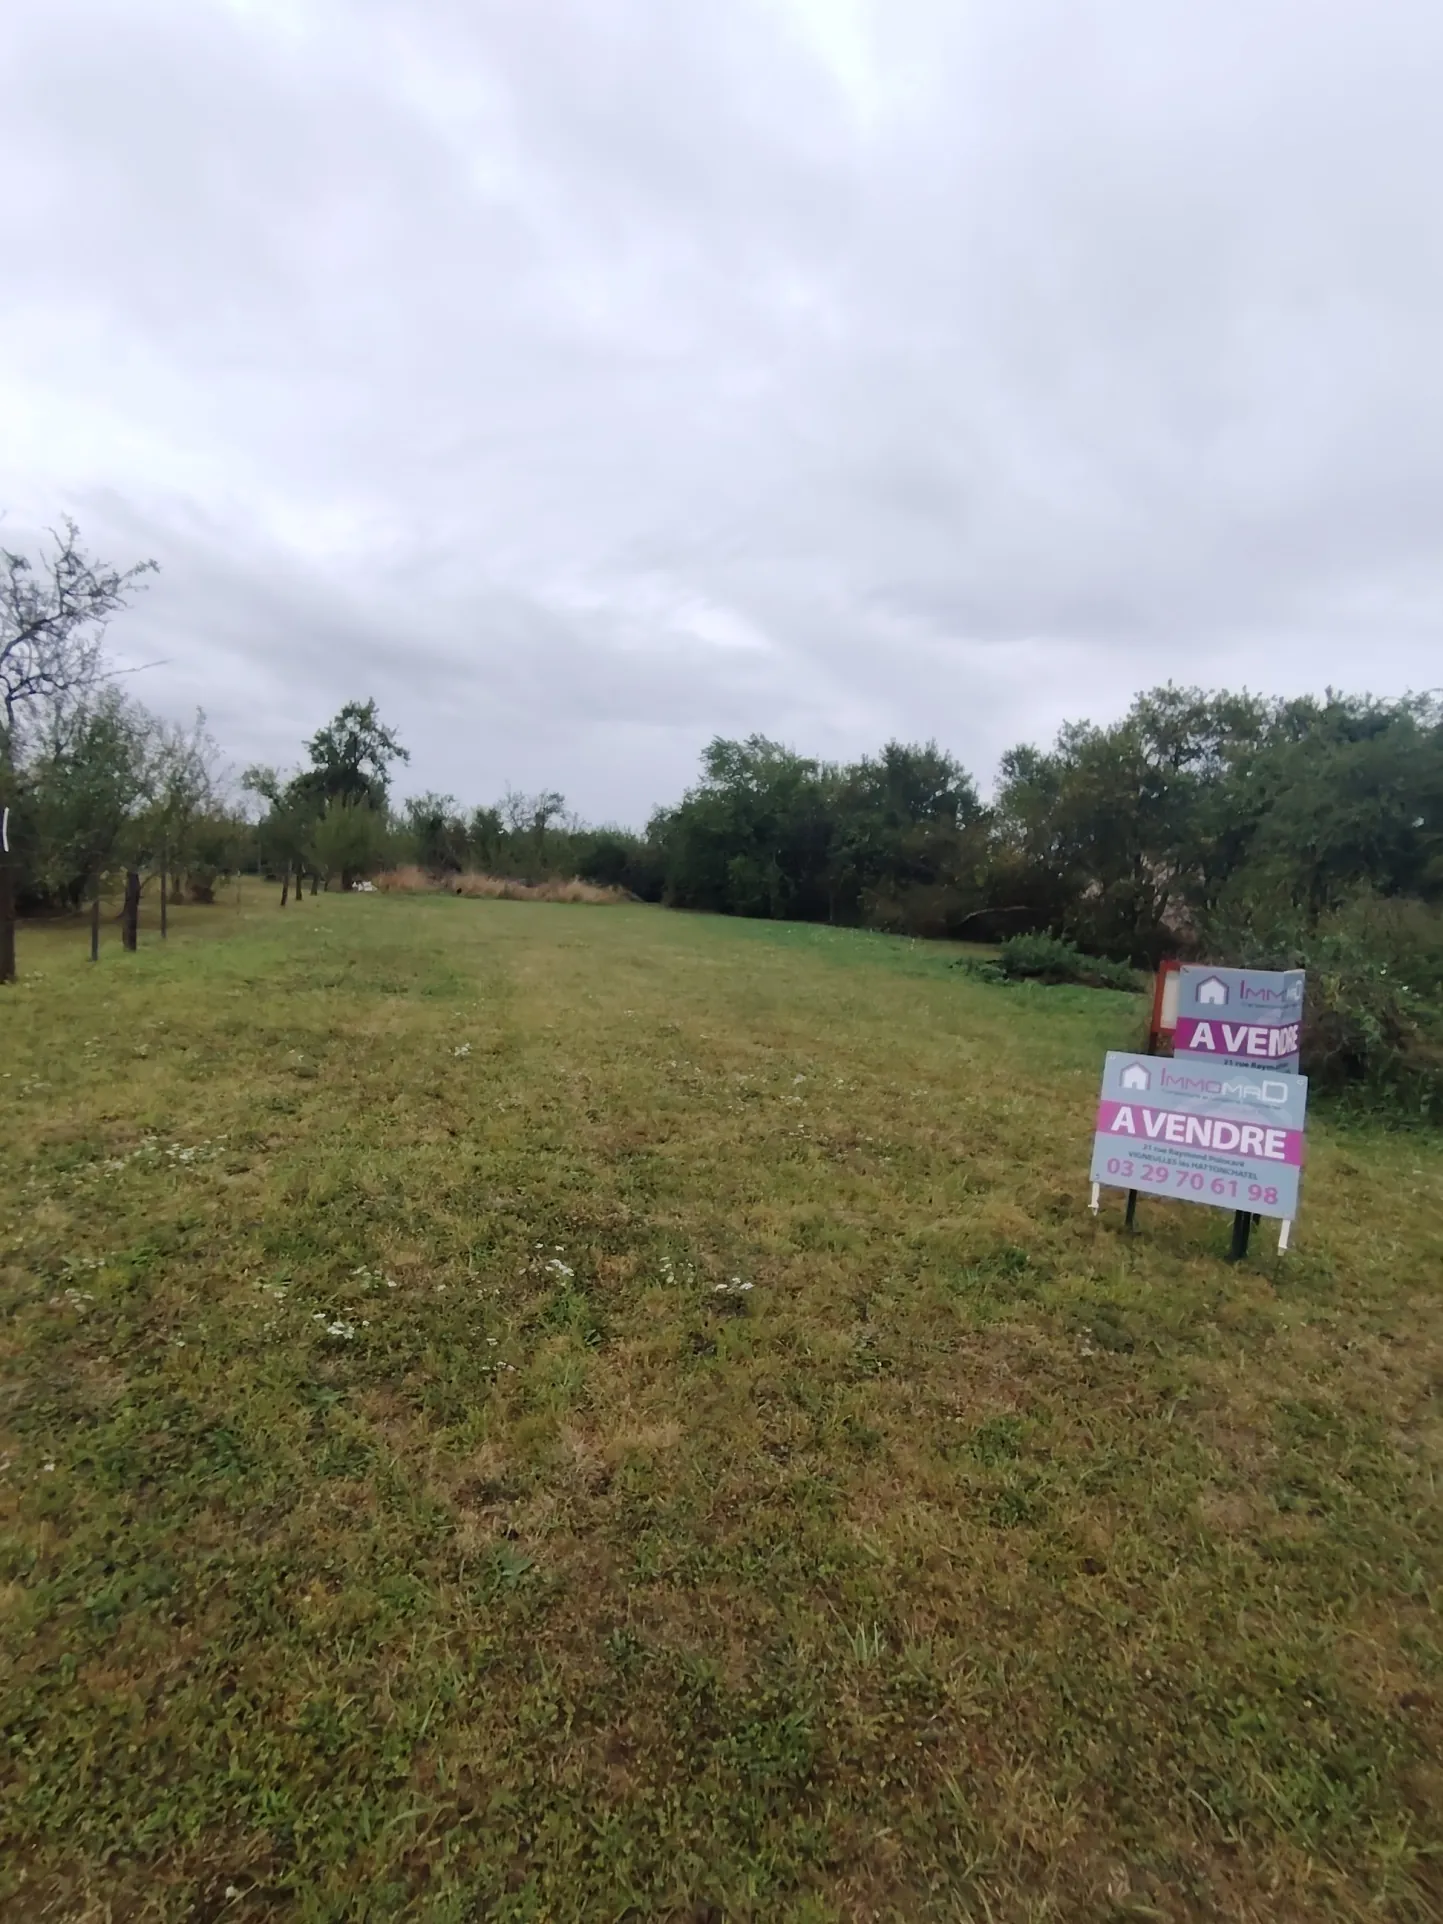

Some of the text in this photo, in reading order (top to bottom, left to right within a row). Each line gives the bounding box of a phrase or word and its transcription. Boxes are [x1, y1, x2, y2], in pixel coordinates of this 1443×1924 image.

[1189, 1022, 1216, 1050] A
[1111, 1106, 1287, 1160] A VENDRE
[1106, 1157, 1278, 1206] 03 29 70 61 98
